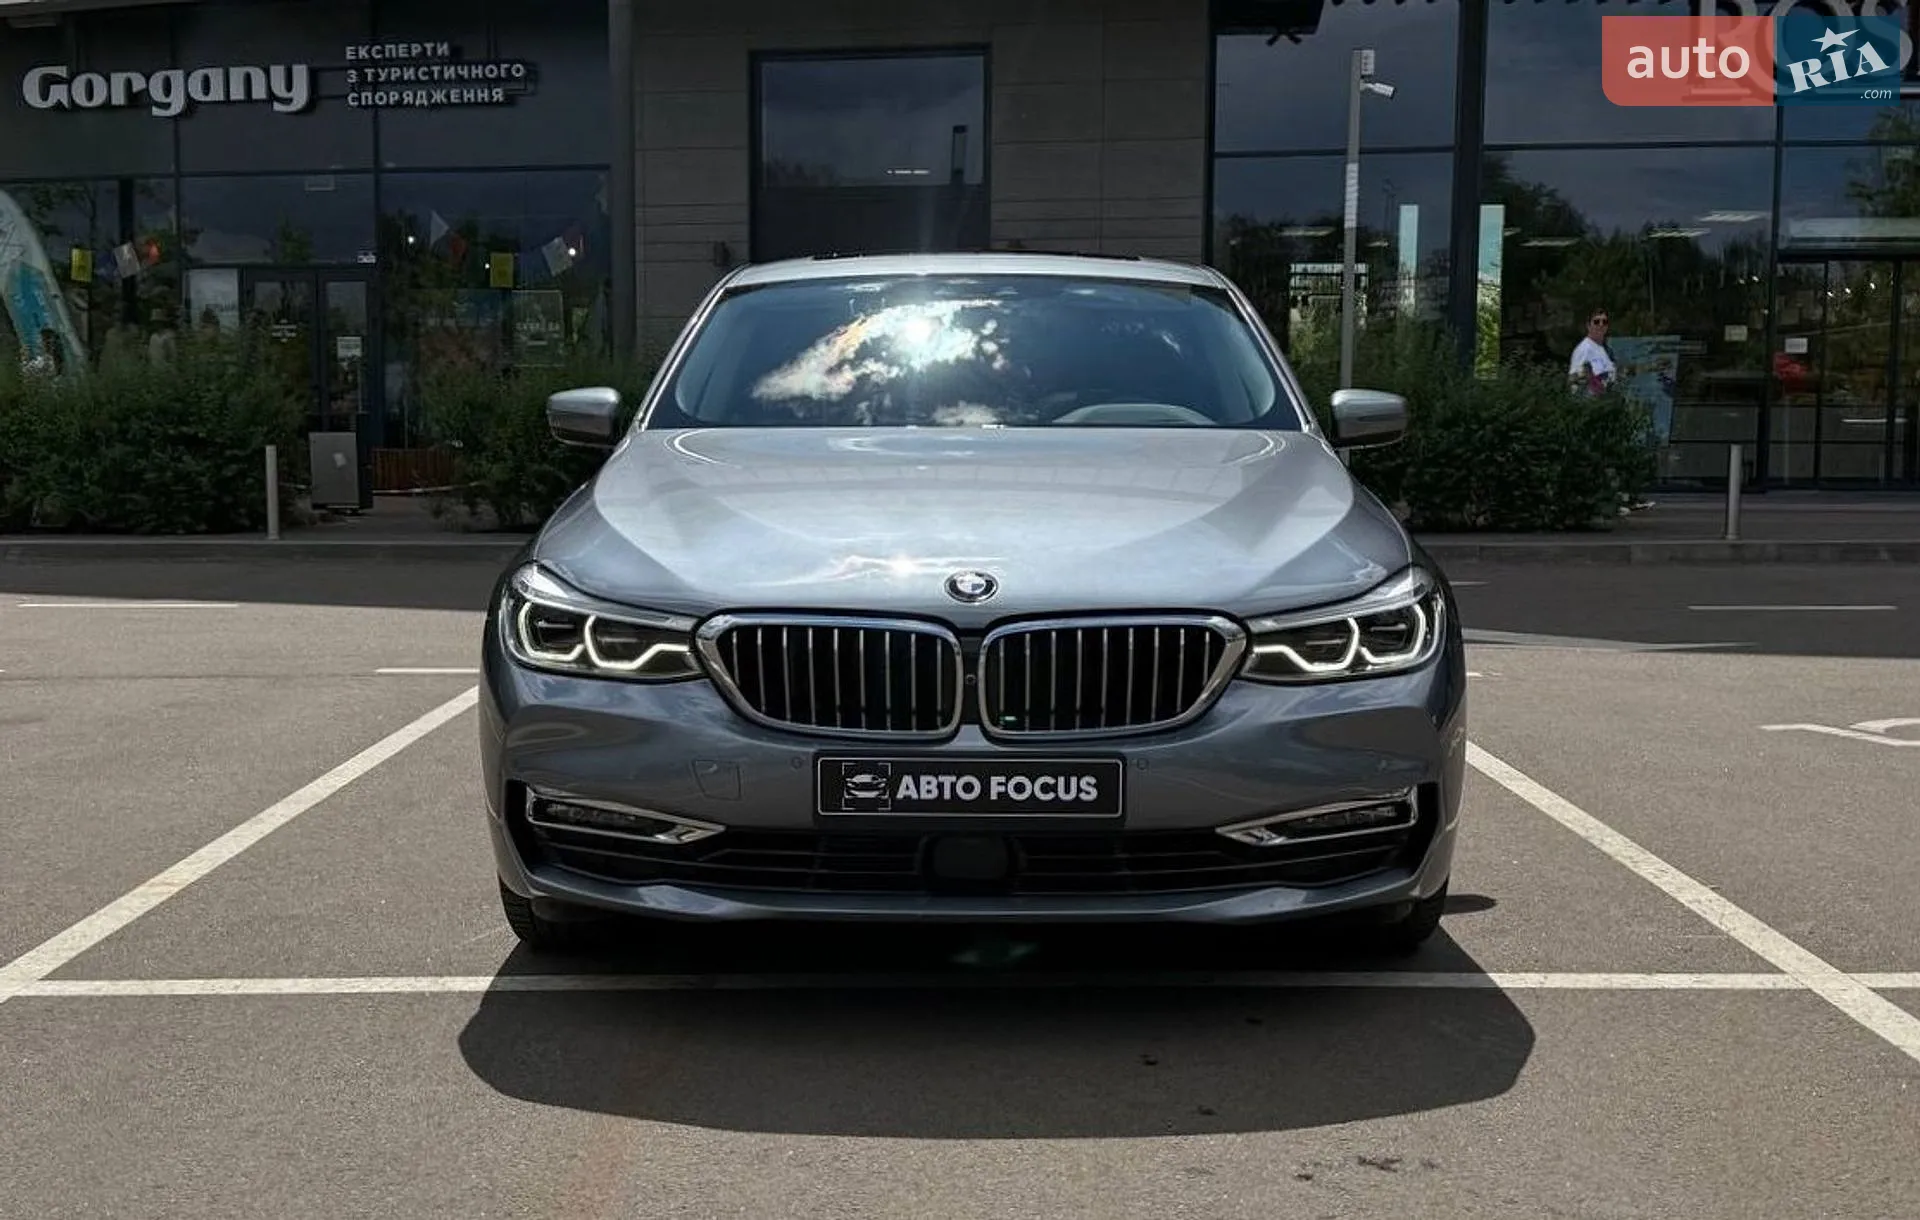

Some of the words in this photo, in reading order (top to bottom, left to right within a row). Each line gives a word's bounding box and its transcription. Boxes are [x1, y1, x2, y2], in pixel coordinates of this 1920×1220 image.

[345, 42, 450, 60] ЕКСПЕРТИ
[347, 69, 358, 84] З
[364, 63, 526, 83] ТУРИСТИЧНОГО
[22, 63, 308, 117] Gorgany
[347, 88, 506, 107] СПОРЯДЖЕННЯ
[896, 774, 982, 801] АВТО
[990, 775, 1098, 801] FOCUS
